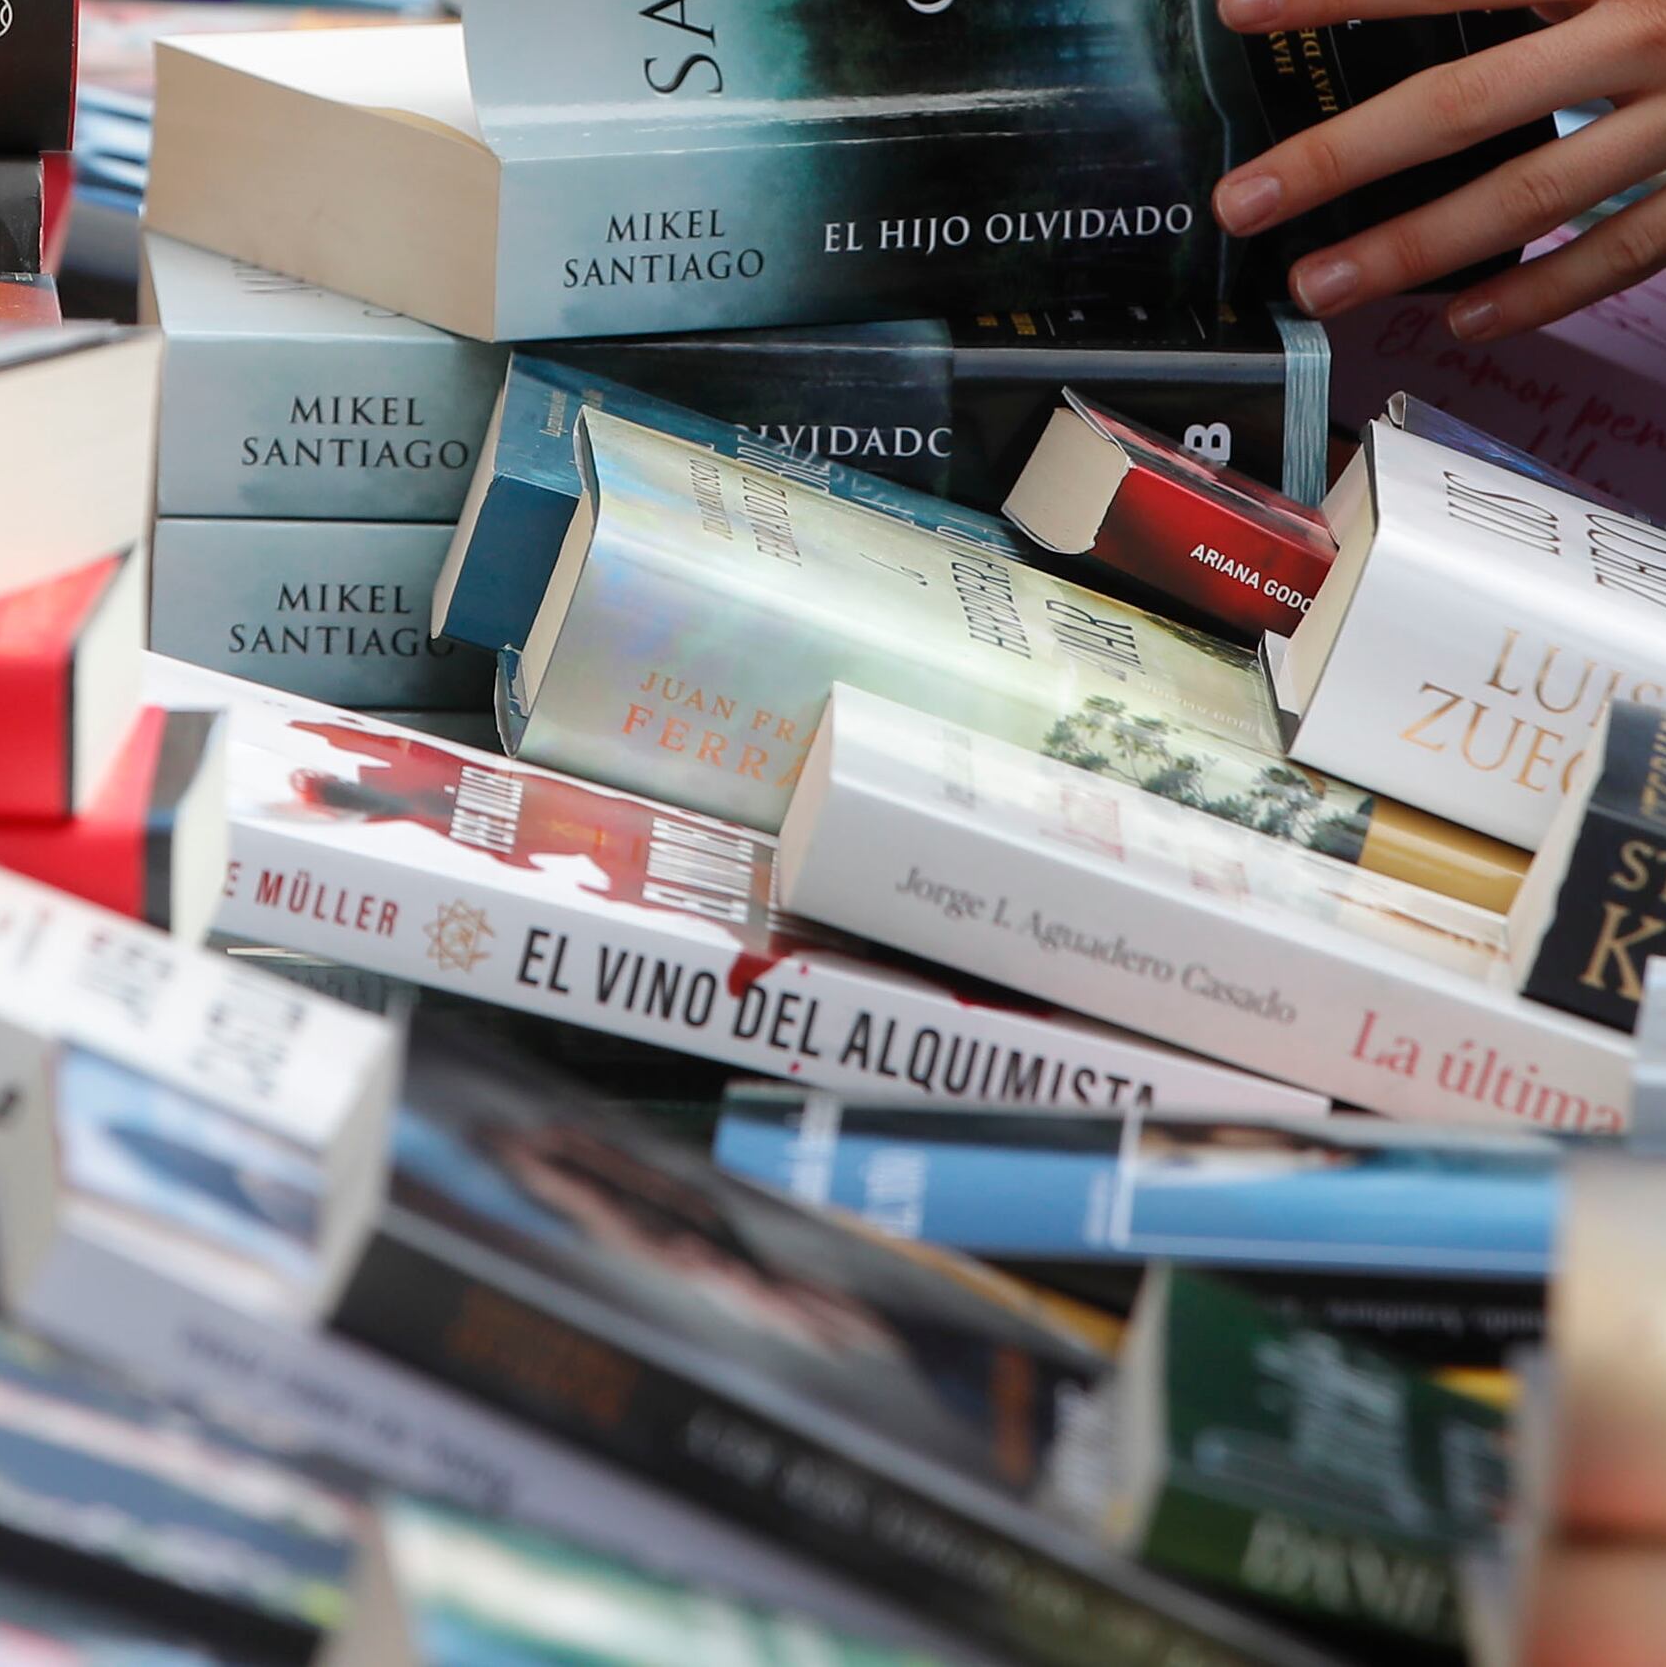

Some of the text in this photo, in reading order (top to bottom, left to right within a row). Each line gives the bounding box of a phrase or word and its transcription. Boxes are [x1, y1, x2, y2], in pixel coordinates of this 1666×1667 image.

[1308, 65, 1339, 111] HAY
[605, 209, 726, 244] MIKEL
[823, 203, 1195, 255] EL HIJO OLVIDADO
[563, 248, 765, 289] SANTIAGO
[290, 396, 425, 427] MIKEL
[241, 437, 470, 470] SANTIAGO
[1443, 470, 1561, 556] LUIS
[277, 582, 412, 615] MIKEL
[1190, 543, 1315, 614] ARIANA GODO
[640, 672, 737, 721] JUAN
[255, 870, 399, 937] MÜLLER
[515, 927, 572, 995] EL
[596, 945, 718, 1029] VINO
[733, 985, 823, 1059] DEL
[896, 865, 987, 921] Jorge
[1018, 909, 1176, 984] Aguadero
[1181, 961, 1298, 1025] Casado
[1351, 1007, 1418, 1079] La
[1436, 1025, 1626, 1136] última
